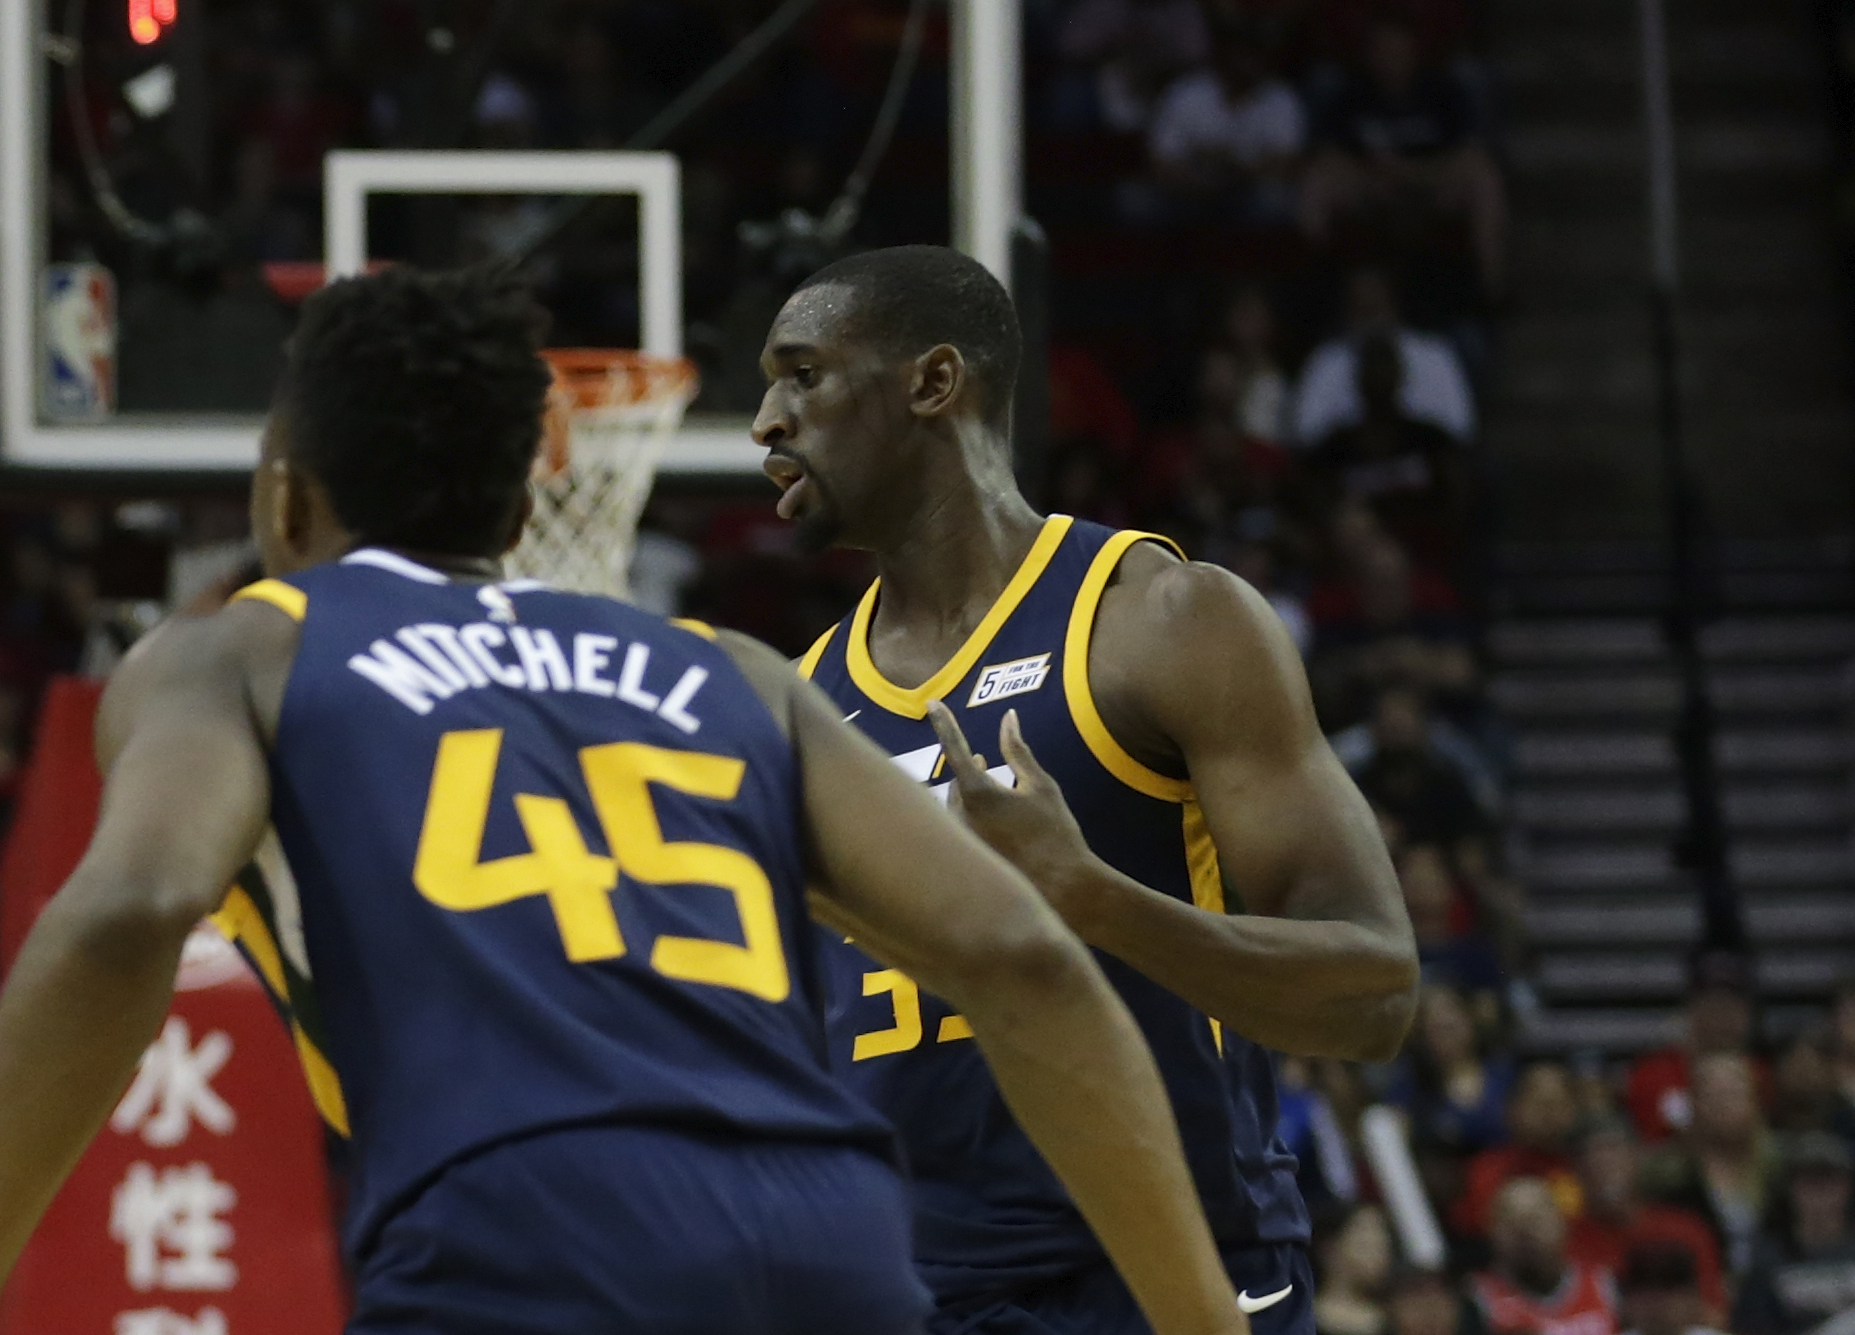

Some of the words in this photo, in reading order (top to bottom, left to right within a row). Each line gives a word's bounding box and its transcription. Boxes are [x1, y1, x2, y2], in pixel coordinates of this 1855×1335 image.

[347, 622, 710, 735] MITCHELL
[978, 670, 1002, 699] 5
[998, 673, 1042, 694] FIGHT
[411, 727, 791, 1003] 45
